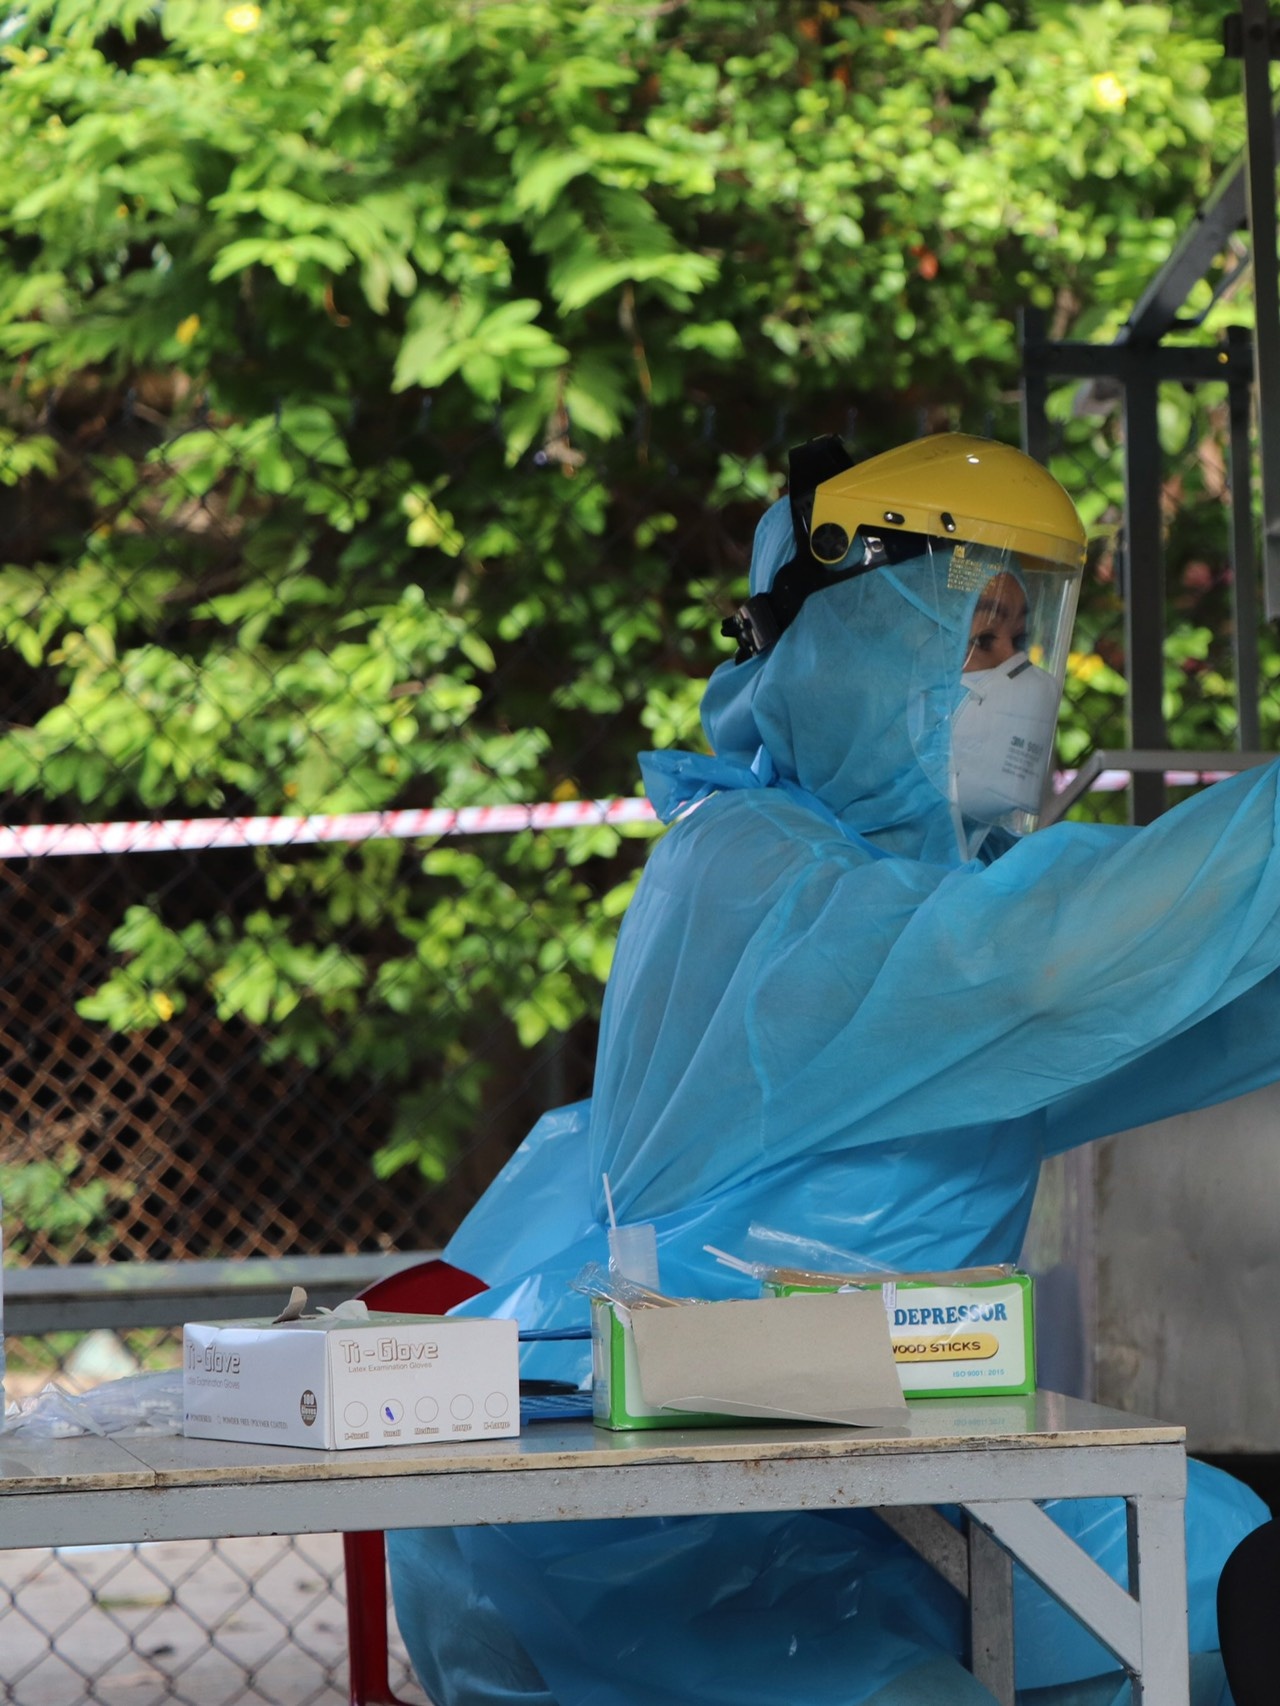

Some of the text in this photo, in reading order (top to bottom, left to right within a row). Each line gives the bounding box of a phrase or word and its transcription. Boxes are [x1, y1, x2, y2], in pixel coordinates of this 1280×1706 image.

[894, 1302, 1007, 1327] DEPRESSOR
[930, 1340, 981, 1353] STICKS
[348, 1361, 433, 1374] Latex Examination Gloves
